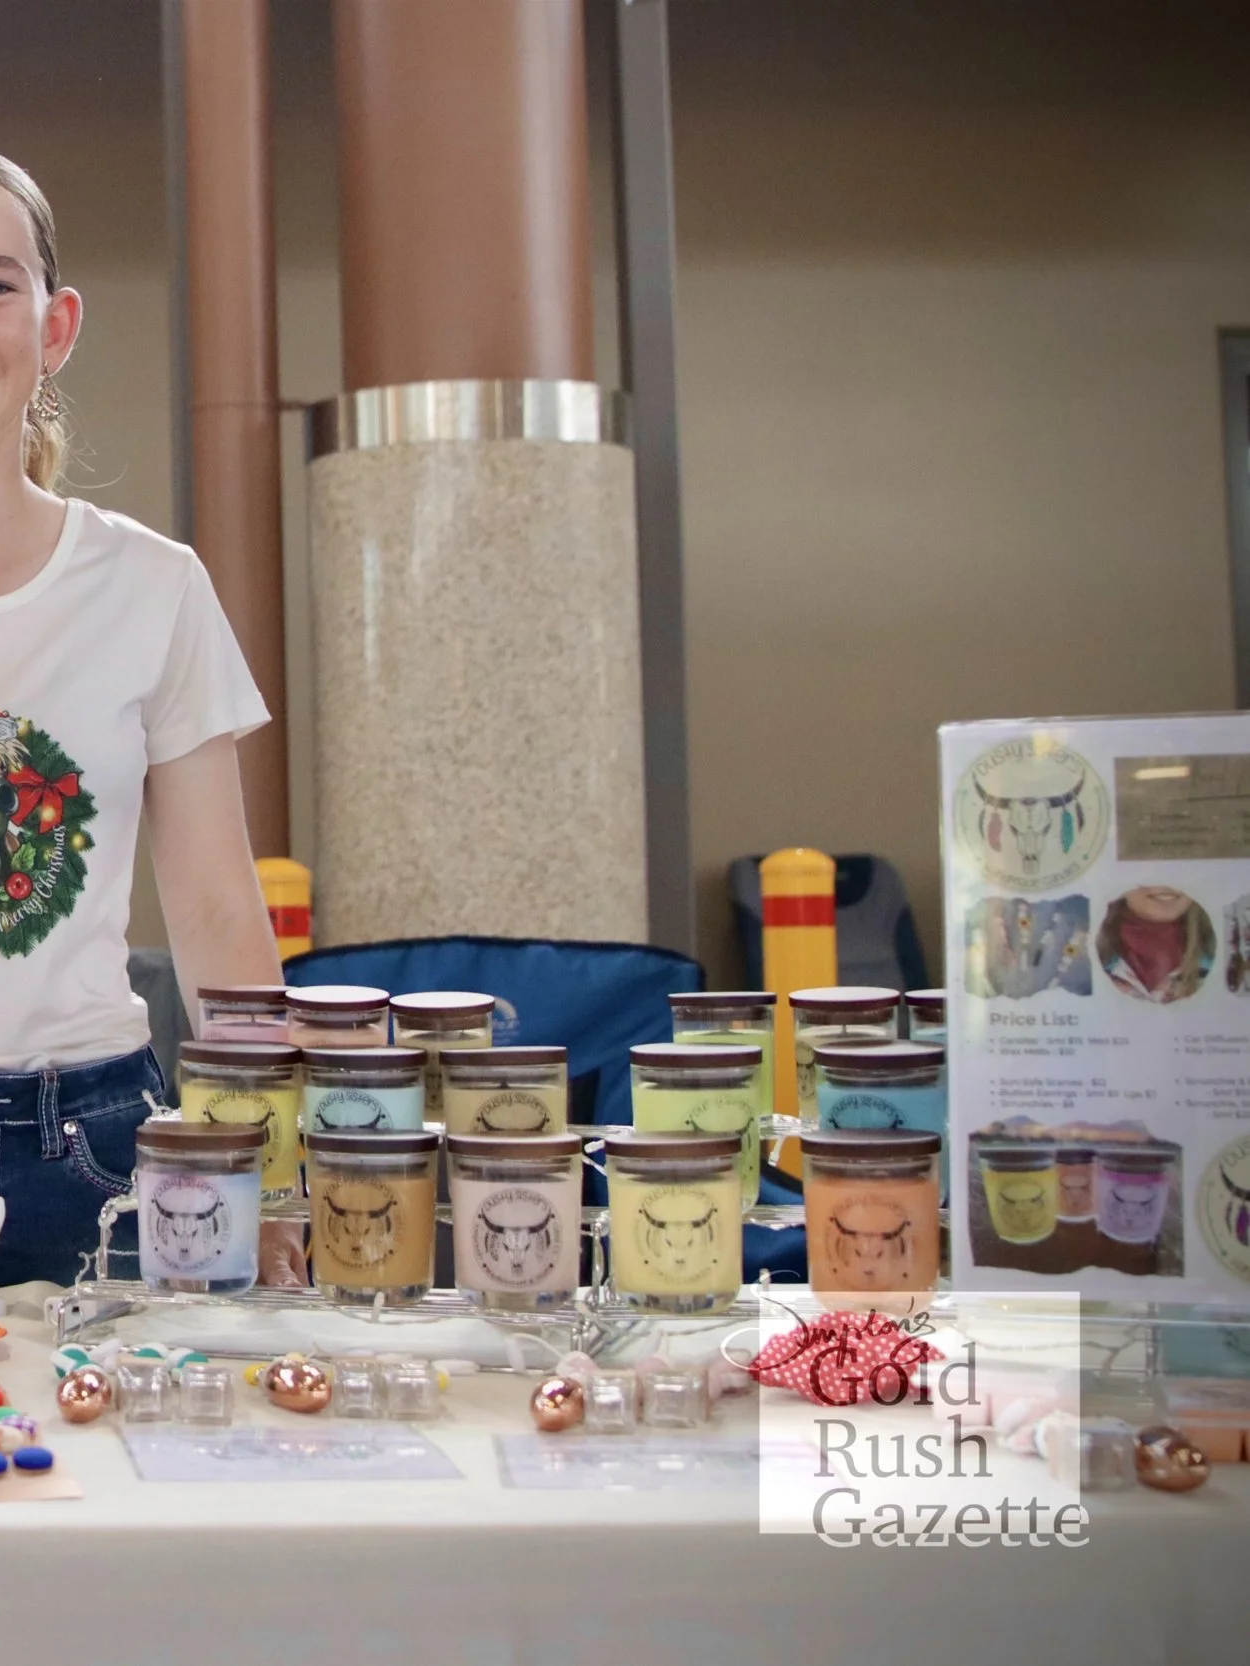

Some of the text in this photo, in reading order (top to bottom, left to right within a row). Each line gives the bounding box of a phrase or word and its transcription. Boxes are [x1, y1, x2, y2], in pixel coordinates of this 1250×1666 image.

[35, 824, 67, 899] Christmas
[989, 1011, 1079, 1027] Price List:
